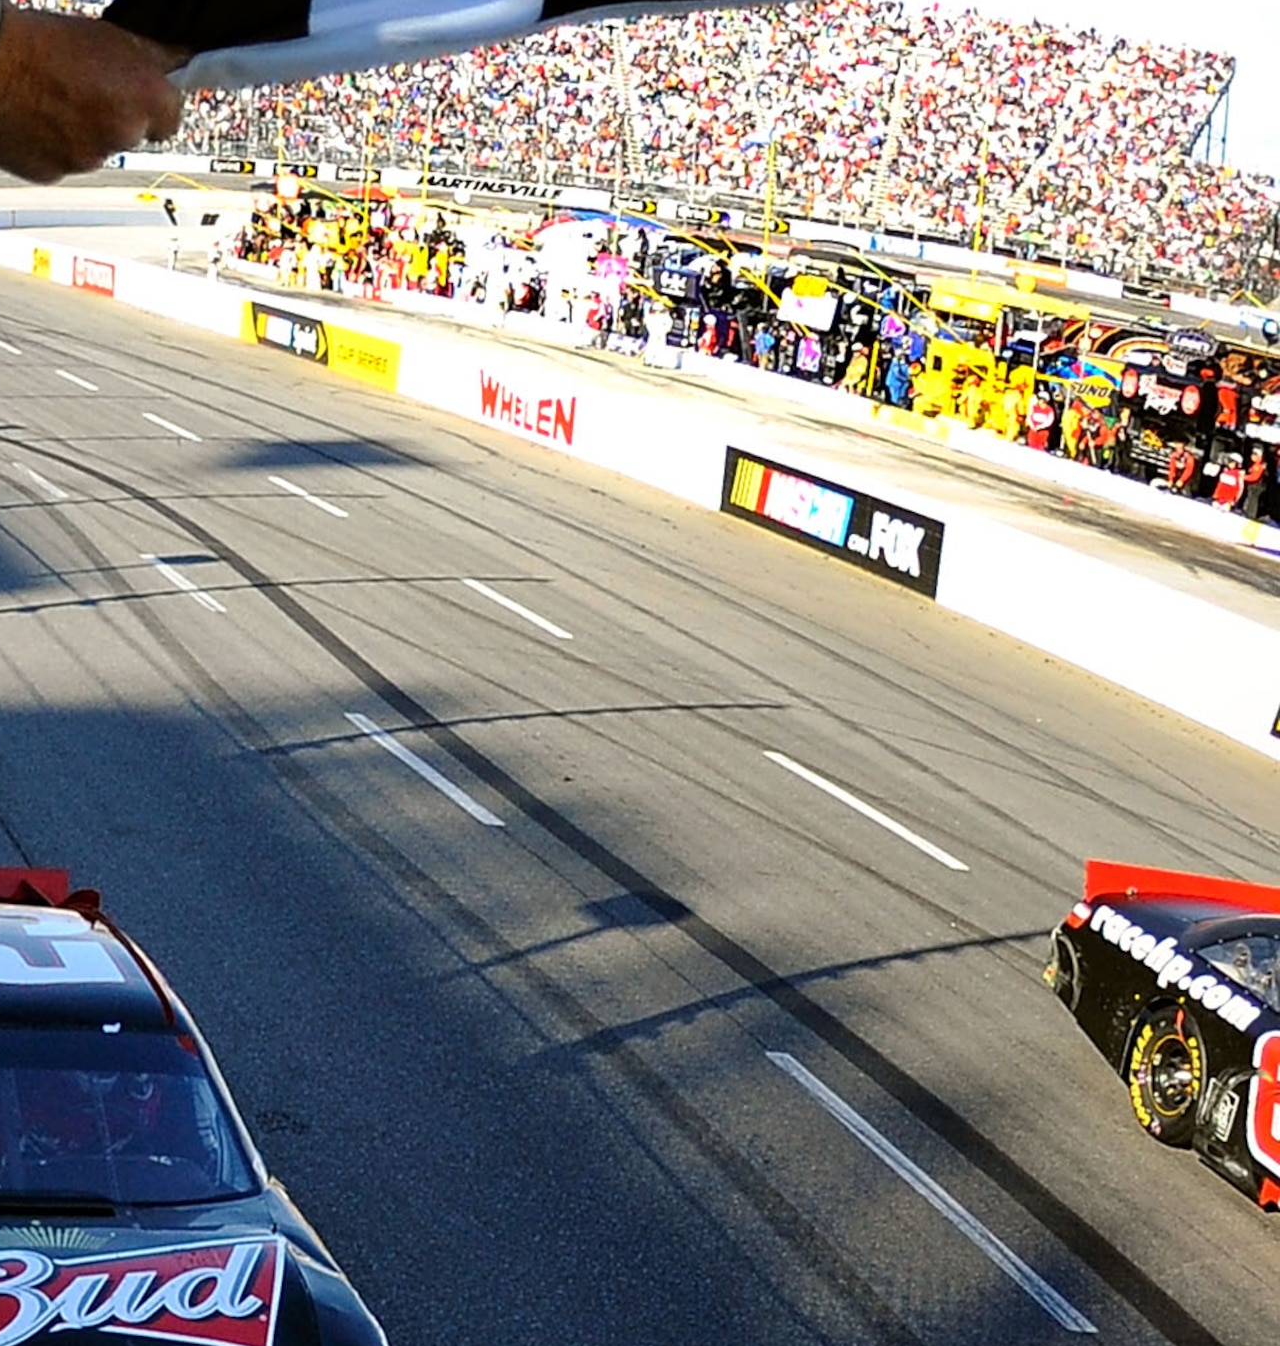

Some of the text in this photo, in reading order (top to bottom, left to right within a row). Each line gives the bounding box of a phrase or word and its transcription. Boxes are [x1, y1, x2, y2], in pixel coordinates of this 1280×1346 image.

[417, 175, 564, 199] MARTINSVILLE
[480, 370, 577, 445] WHELEN
[869, 511, 926, 578] FOX
[1089, 903, 1261, 1033] racehp.com
